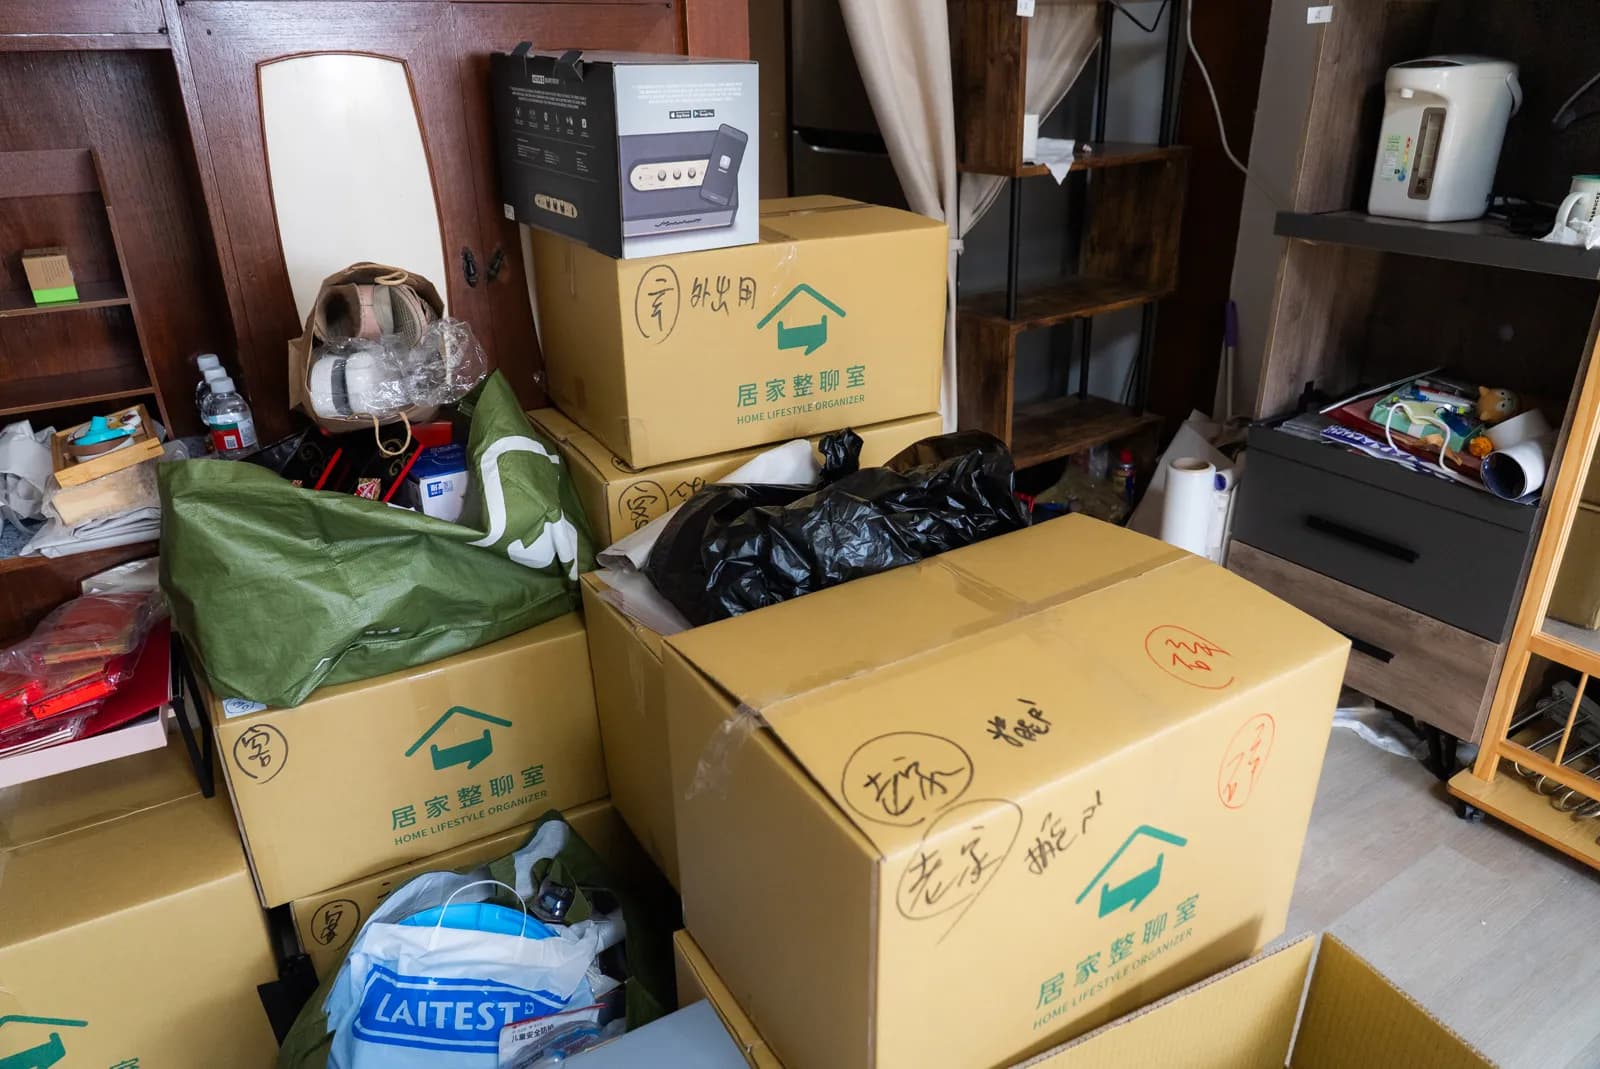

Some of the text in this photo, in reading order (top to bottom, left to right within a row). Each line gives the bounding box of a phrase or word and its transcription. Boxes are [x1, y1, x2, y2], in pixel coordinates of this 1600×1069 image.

[690, 274, 757, 316] 外出用
[736, 394, 865, 425] HOME LIFESTYLE ORGANIZER
[737, 364, 866, 408] 居家整聊室
[392, 764, 545, 831] 居家整聊室
[394, 789, 548, 846] HOME LIFESTYLE ORGANIZER
[1035, 893, 1200, 1010] 居家整聊室
[1033, 927, 1194, 1030] HOME LIFESTYLE ORGANIZER
[374, 992, 521, 1032] LAITEST
